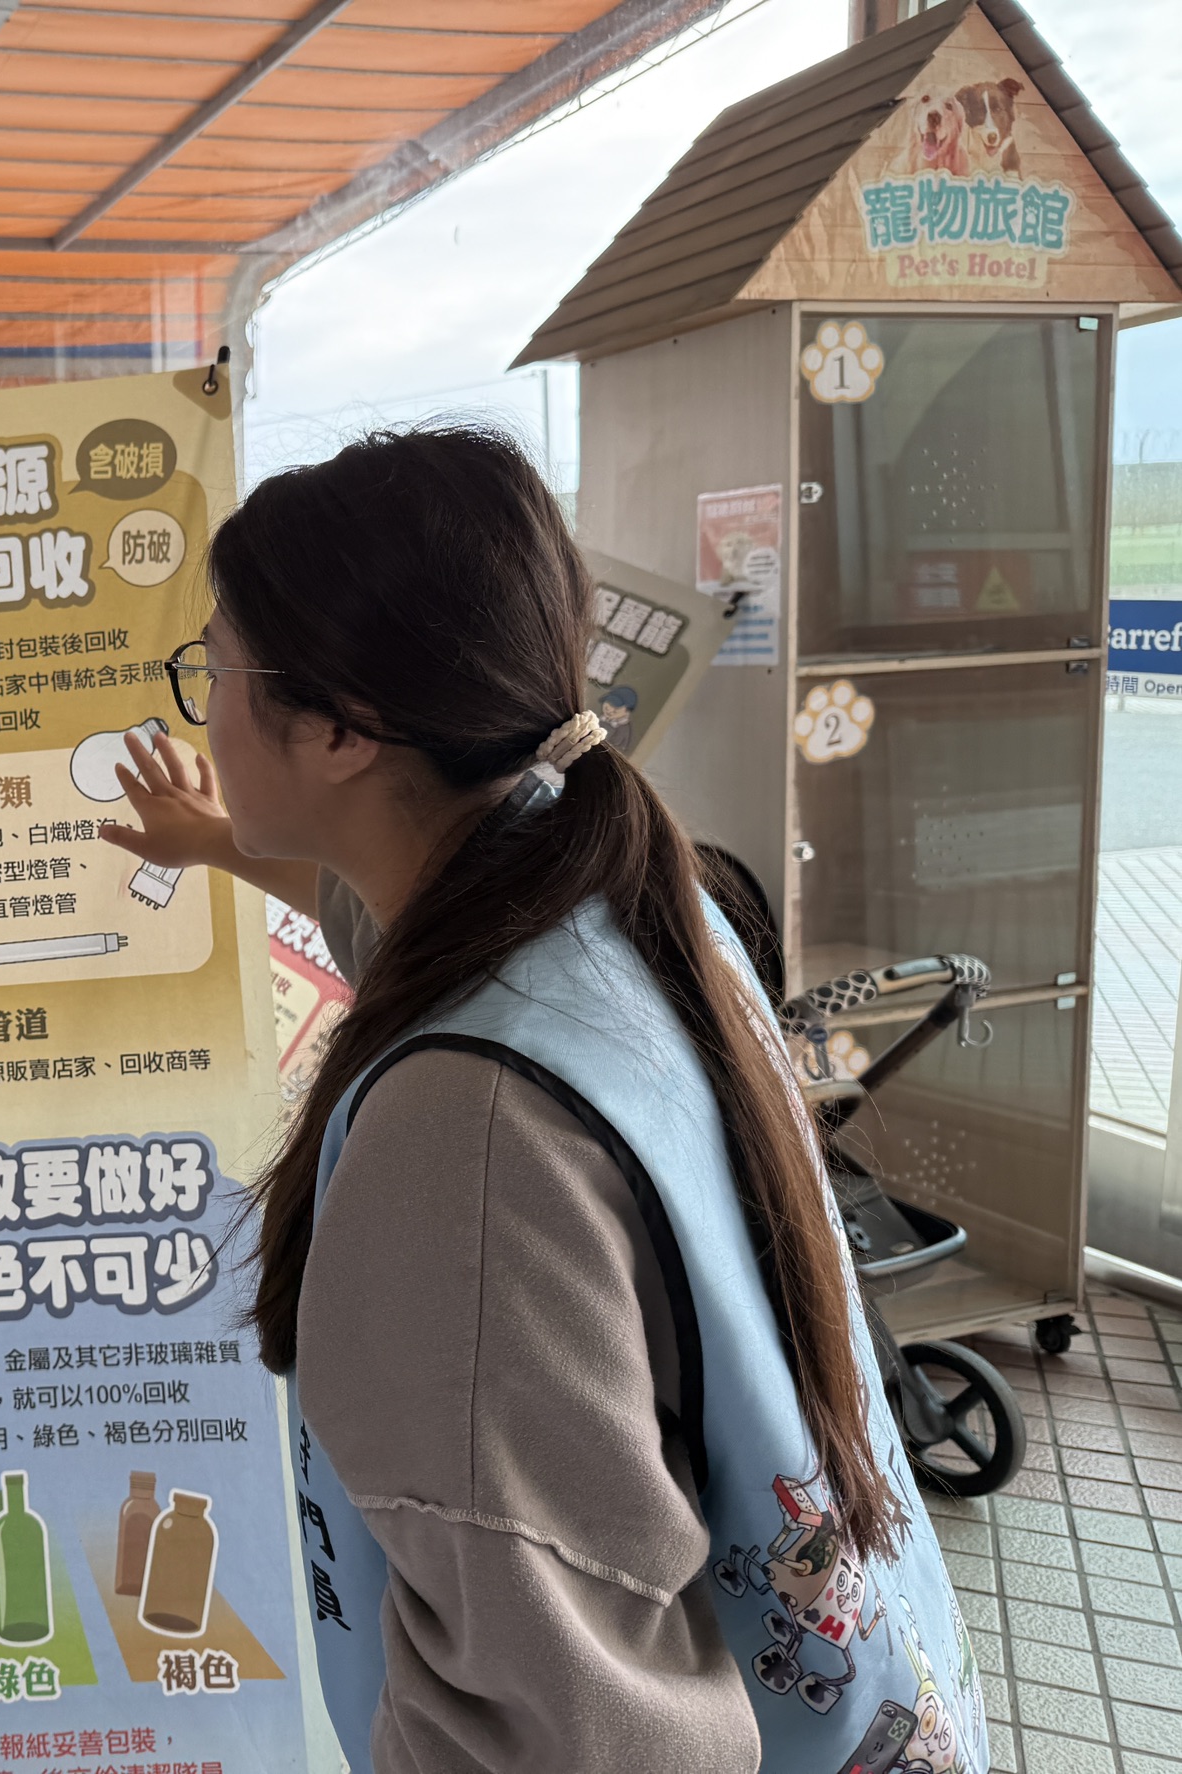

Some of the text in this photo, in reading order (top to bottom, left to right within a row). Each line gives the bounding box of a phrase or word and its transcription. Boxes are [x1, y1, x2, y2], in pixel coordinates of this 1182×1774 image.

[863, 177, 1070, 250] 寵物旅館
[897, 253, 1038, 281] Pet's Hotel
[832, 353, 851, 391] 1
[88, 443, 165, 482] 含破損
[121, 529, 172, 566] 防破
[1107, 621, 1182, 652] arref
[824, 714, 843, 748] 2
[160, 1653, 236, 1692] 褐色
